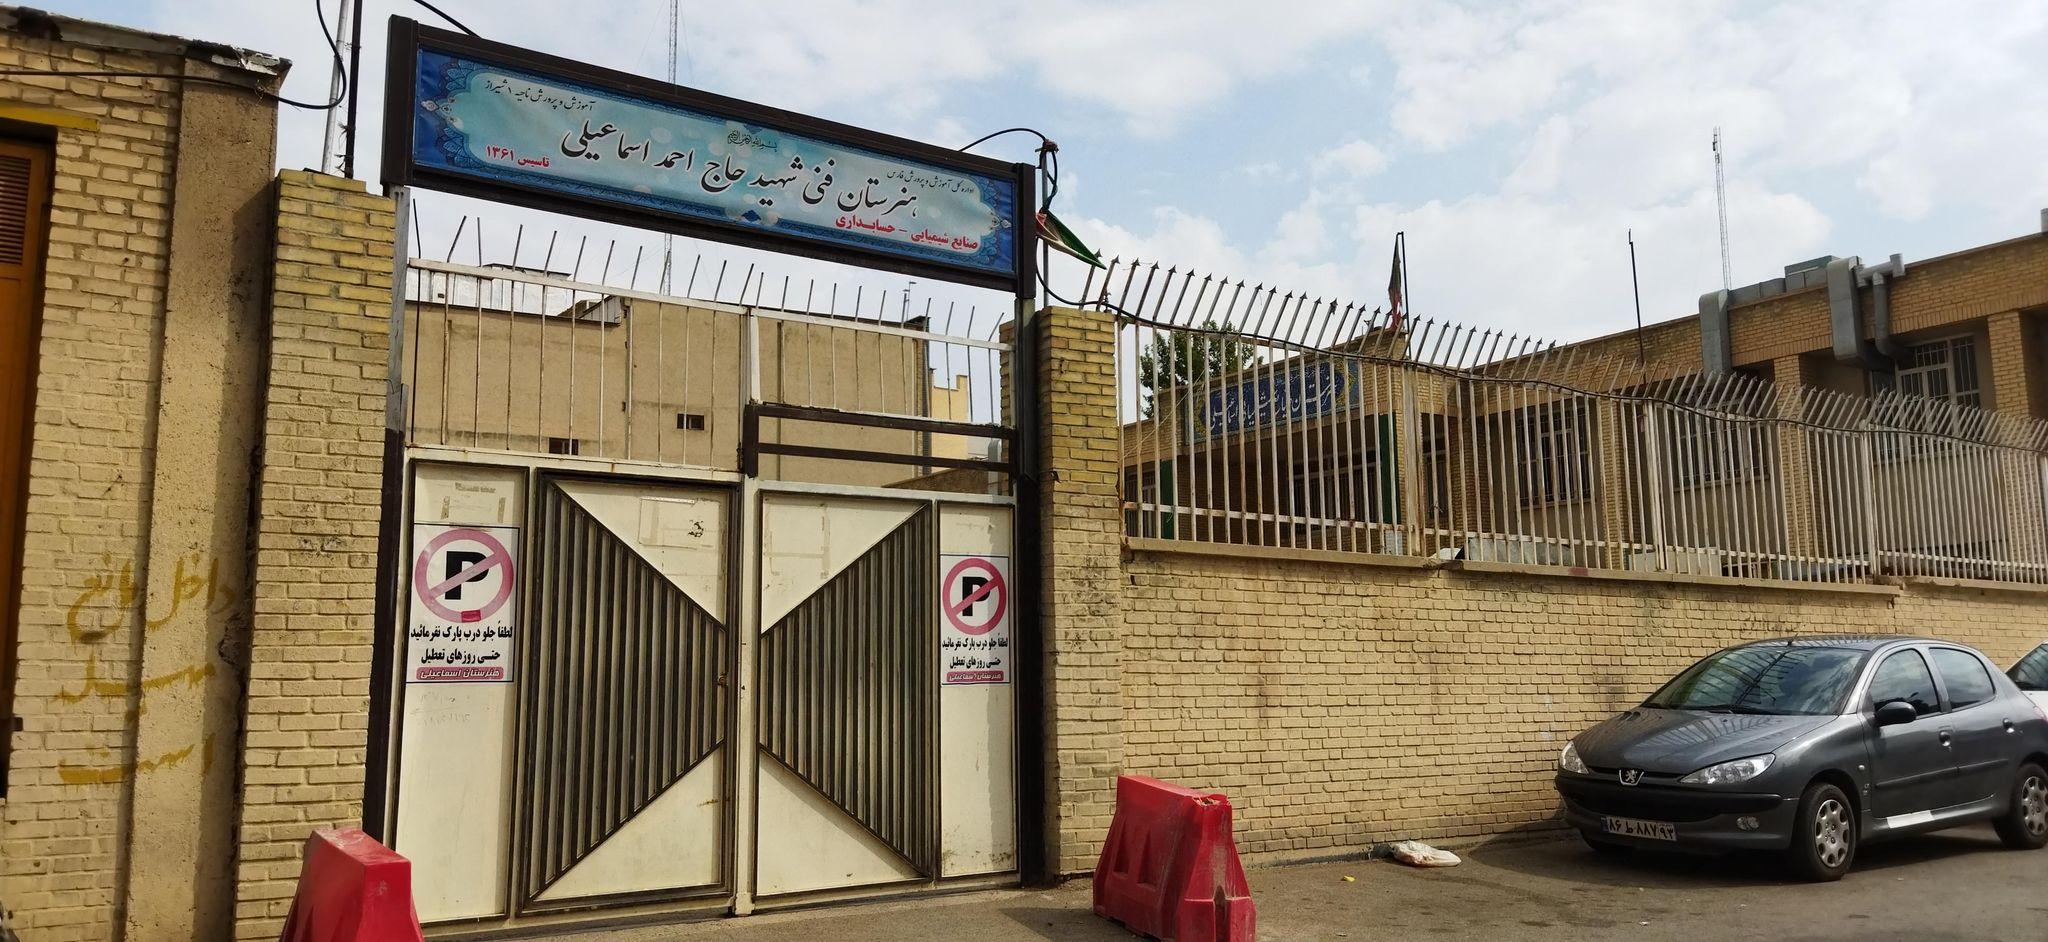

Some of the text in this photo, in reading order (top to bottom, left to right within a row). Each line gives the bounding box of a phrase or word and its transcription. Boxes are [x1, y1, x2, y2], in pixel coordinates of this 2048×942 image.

[485, 79, 508, 94] شیراز
[515, 87, 531, 102] ناحیه
[530, 88, 558, 110] پرورش
[564, 96, 597, 111] آموزش
[485, 144, 550, 169] تاسیس ۱۳۶۱
[561, 120, 918, 218] هنرستان فنی شهید حاج احمد اسماعیلی
[887, 170, 904, 179] فارس
[904, 170, 926, 188] پرورش
[929, 176, 952, 188] آموزش
[951, 180, 964, 193] کل
[835, 214, 896, 234] حسابداری
[911, 228, 949, 246] شیمیایی
[951, 235, 978, 250] صنایع
[442, 625, 462, 642] پارک
[463, 628, 480, 642] درب
[482, 626, 496, 642] جلو
[962, 637, 976, 651] پارک
[976, 639, 988, 651] درب
[989, 637, 998, 651] جلو
[421, 648, 501, 665] حتی روزهای تعطیل
[949, 656, 966, 669] تعطیل
[966, 655, 986, 669] روزهای
[420, 668, 501, 680] هنرستان اسماعیلی
